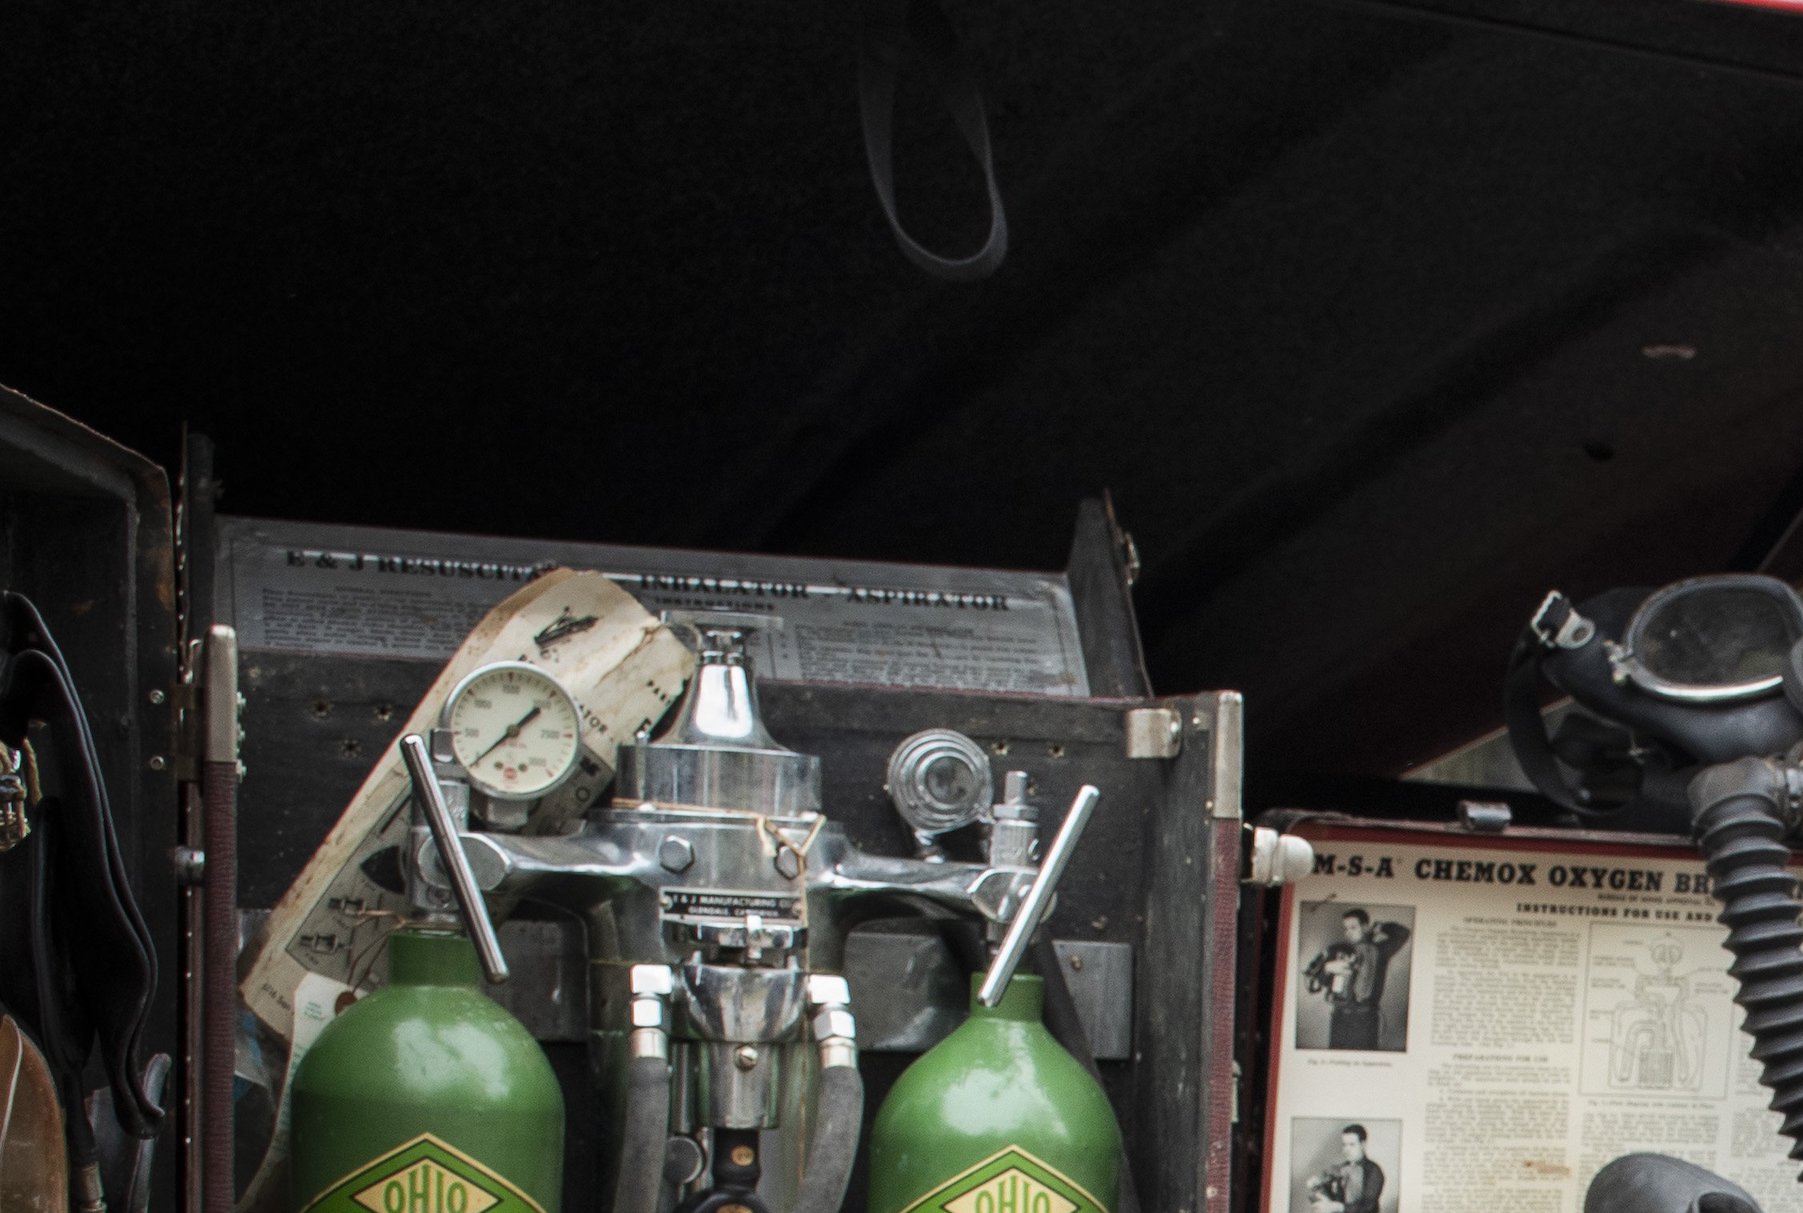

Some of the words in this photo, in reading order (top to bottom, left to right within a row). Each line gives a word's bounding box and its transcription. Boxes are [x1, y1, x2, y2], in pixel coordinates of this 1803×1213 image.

[378, 556, 556, 581] RESUSCITA
[1415, 857, 1537, 886] CHEMOX
[1548, 865, 1663, 893] OXYGEN
[1516, 902, 1619, 918] INSTRUCTIONS
[1623, 907, 1651, 920] FOR
[1655, 908, 1681, 921] USE
[1685, 910, 1713, 923] AND
